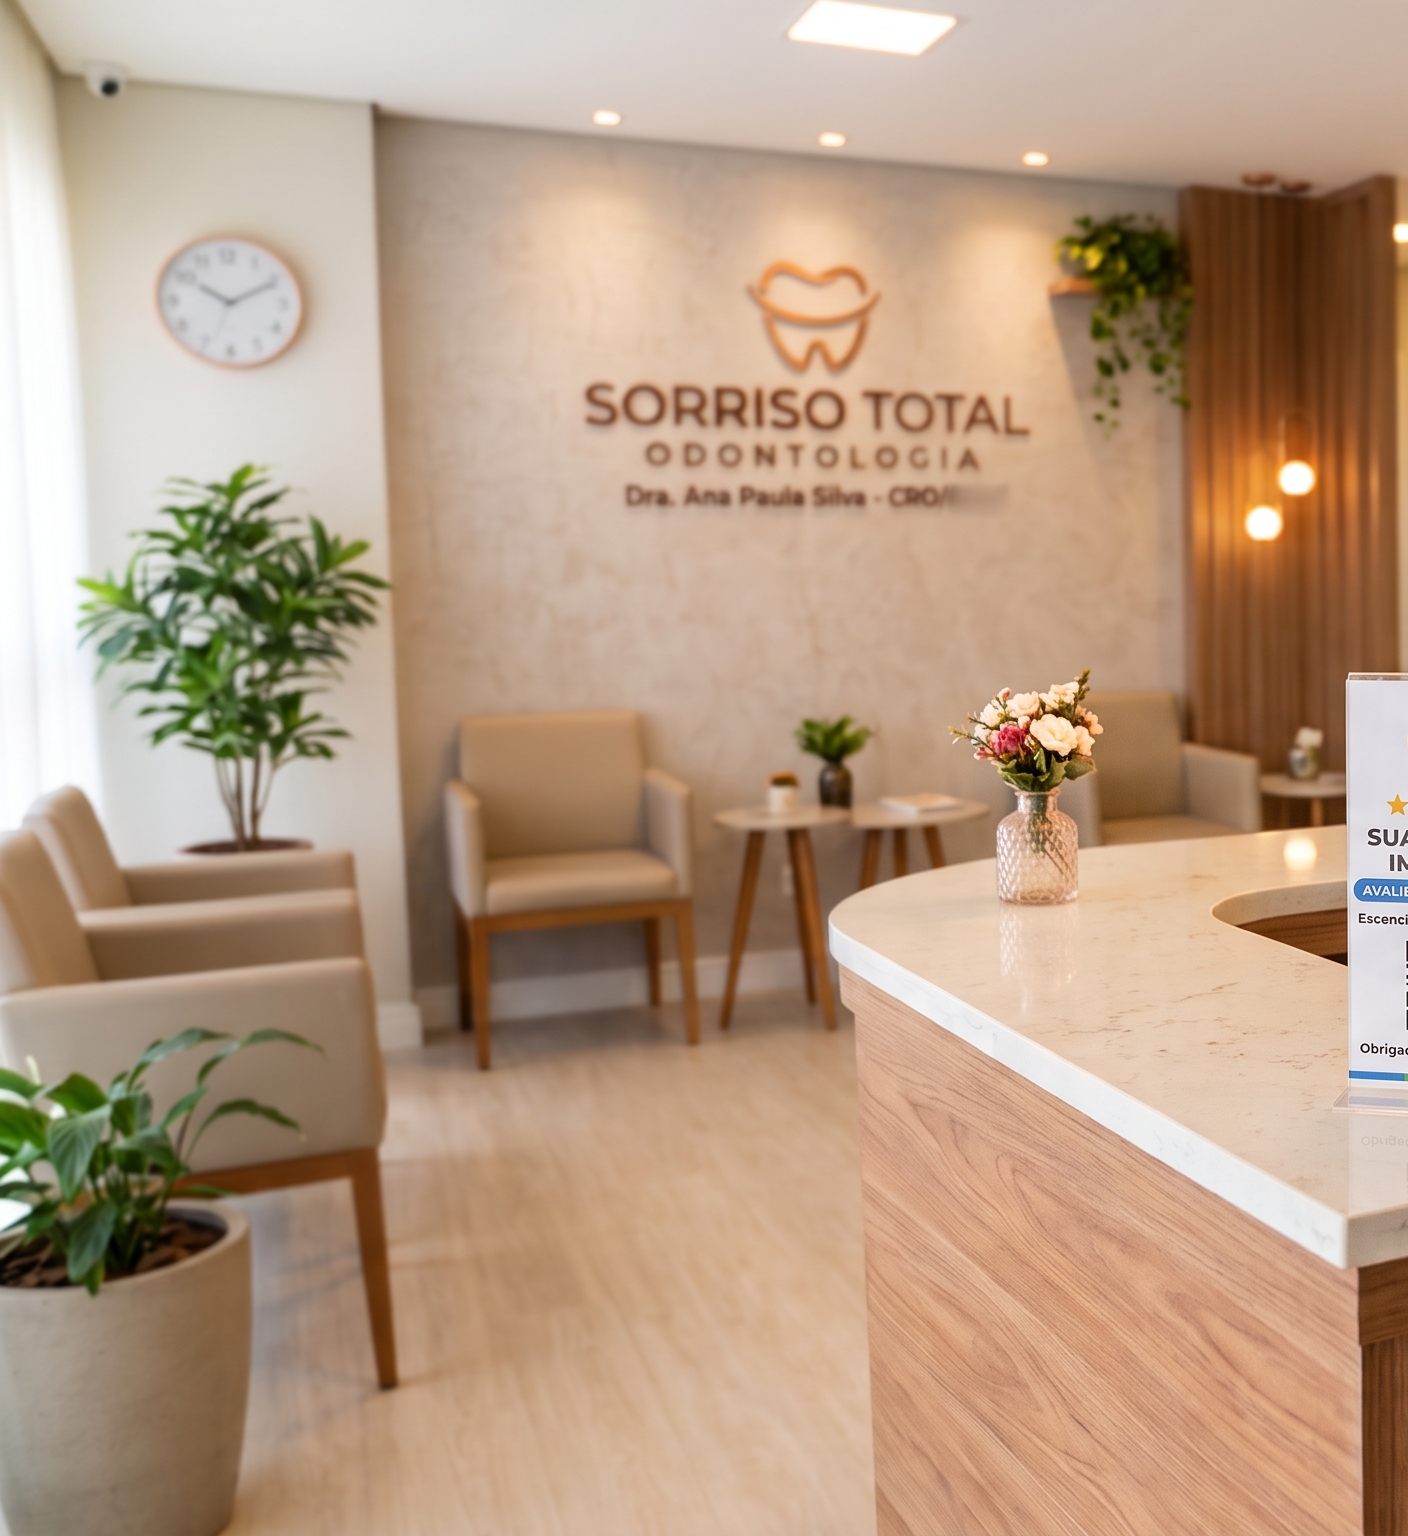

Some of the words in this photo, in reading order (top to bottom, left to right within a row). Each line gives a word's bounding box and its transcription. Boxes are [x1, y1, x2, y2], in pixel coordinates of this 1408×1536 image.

[585, 383, 846, 430] SORRISO
[863, 391, 1030, 436] TOTAL
[645, 442, 980, 471] ODONTOLOGIA
[625, 485, 676, 507] Dra.
[684, 485, 731, 507] Ana
[740, 485, 805, 507] Paula
[813, 485, 867, 508] Silva
